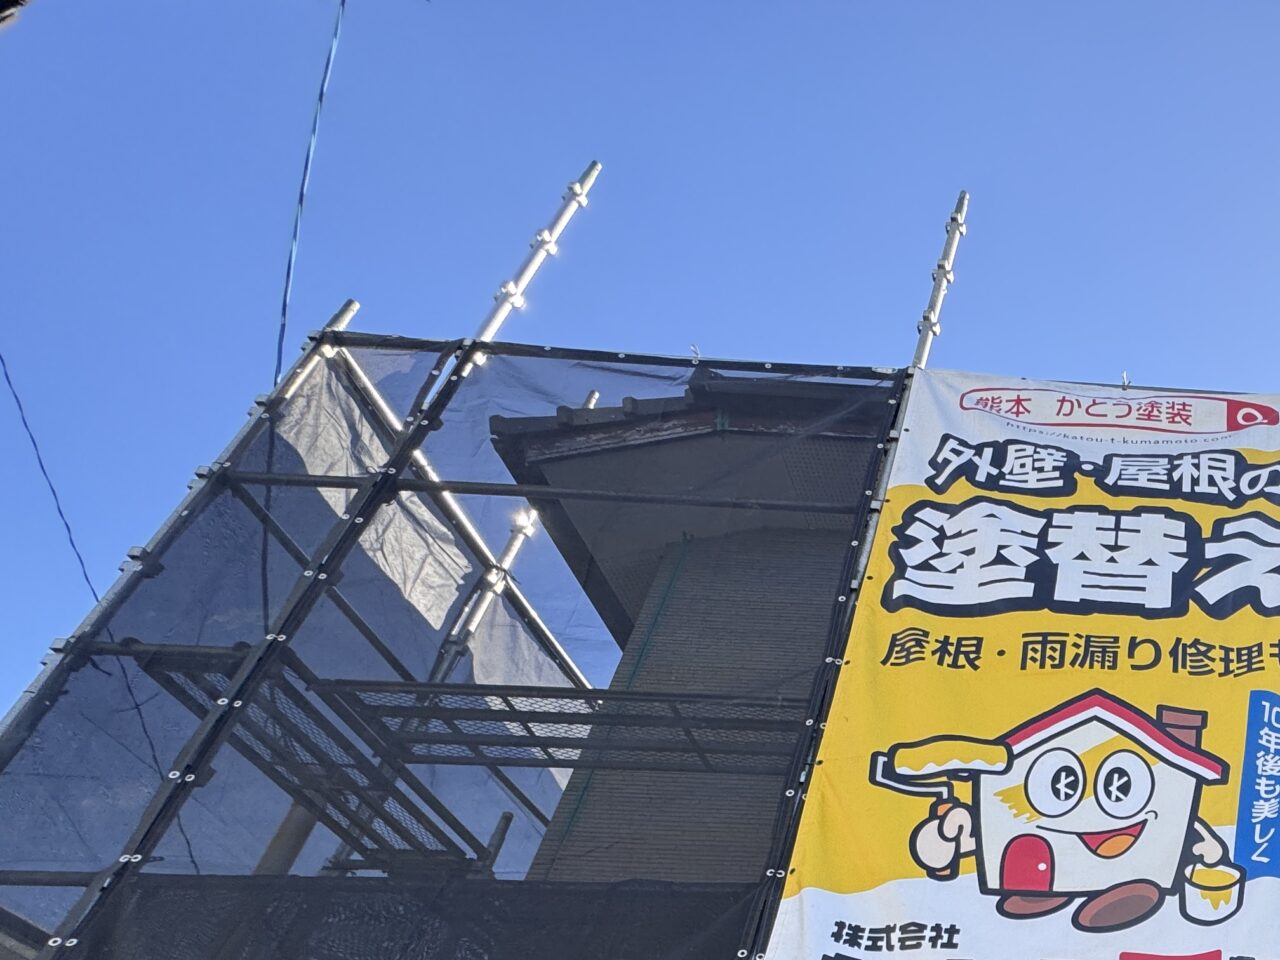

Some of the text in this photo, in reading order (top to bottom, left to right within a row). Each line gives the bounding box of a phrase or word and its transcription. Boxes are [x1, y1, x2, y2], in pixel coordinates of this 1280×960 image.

[974, 394, 1192, 426] 熊本 かとう塗装
[830, 919, 960, 952] 株式会社
